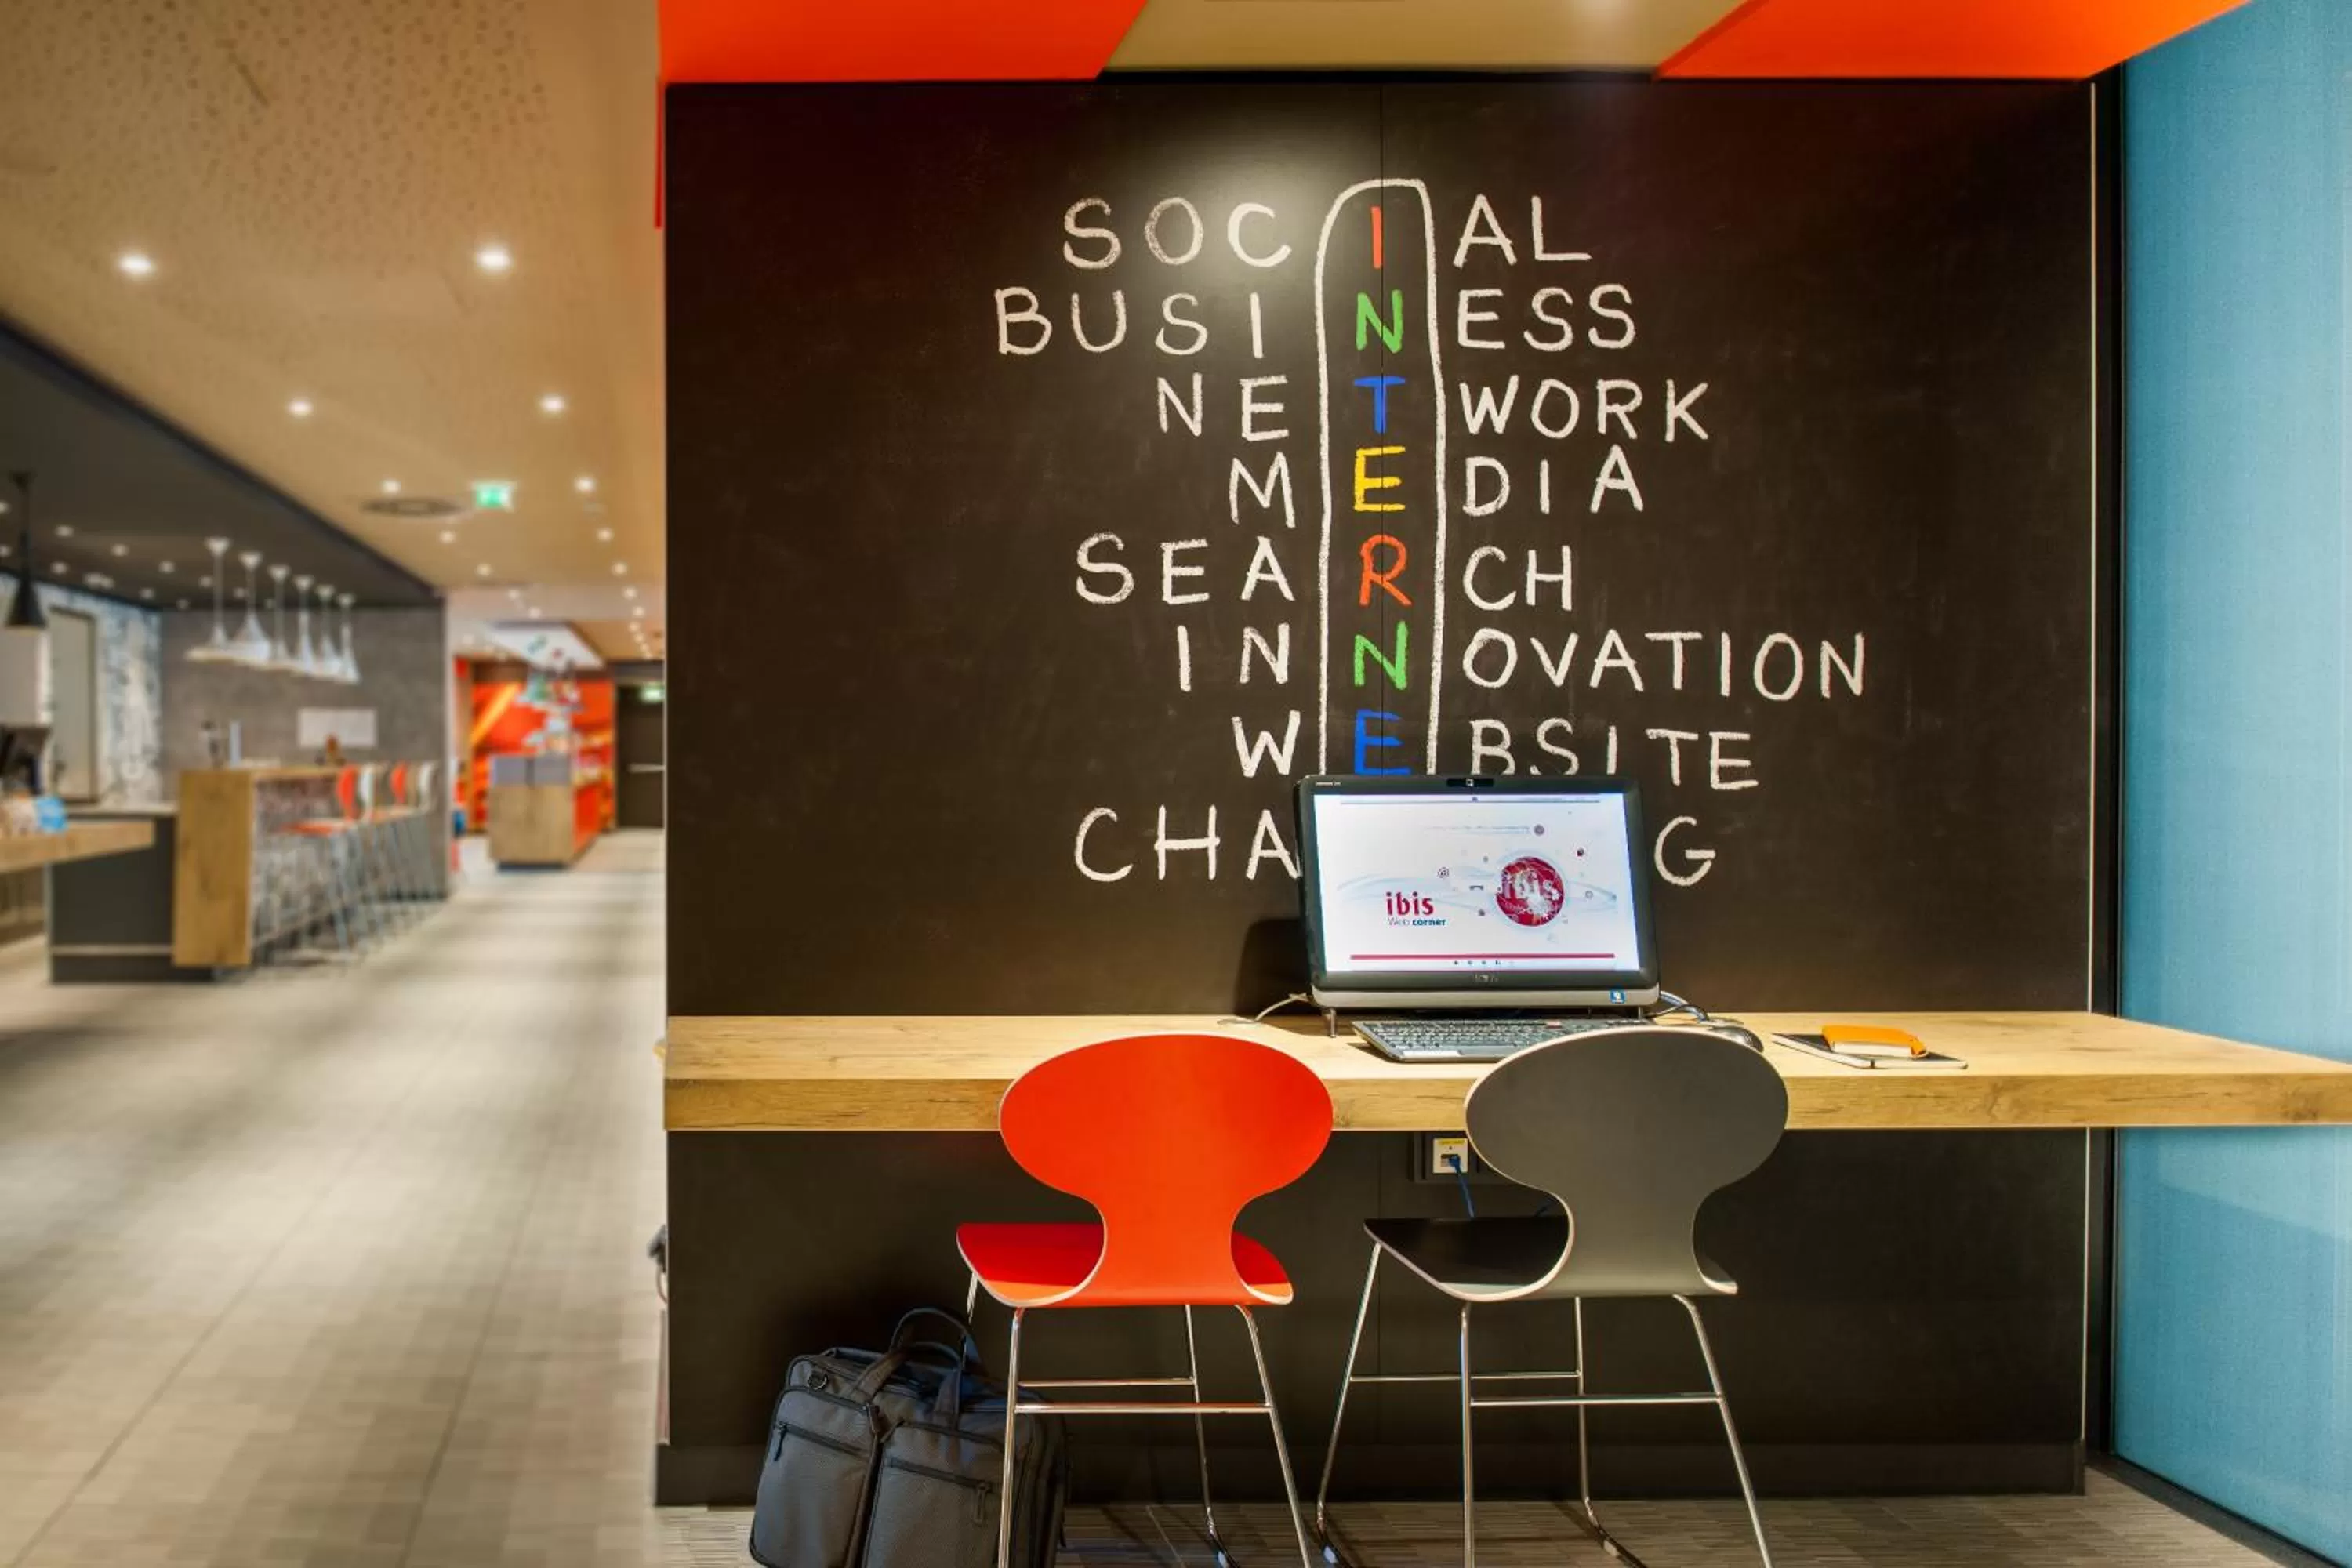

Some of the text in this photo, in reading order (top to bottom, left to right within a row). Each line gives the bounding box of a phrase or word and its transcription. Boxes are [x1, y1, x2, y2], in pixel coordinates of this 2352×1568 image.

[1062, 194, 1592, 270] SOCIAL
[993, 284, 1636, 358] BUSINESS
[1156, 373, 1709, 442] NETWORK
[1228, 445, 1644, 528] MEDIA
[1352, 205, 1414, 775] INTERNE
[1076, 531, 1572, 612] SEARCH
[1178, 621, 1865, 701] INNOVATION
[1231, 710, 1759, 790] WEBSITE
[1386, 891, 1434, 916] ibis
[1412, 918, 1446, 927] corner
